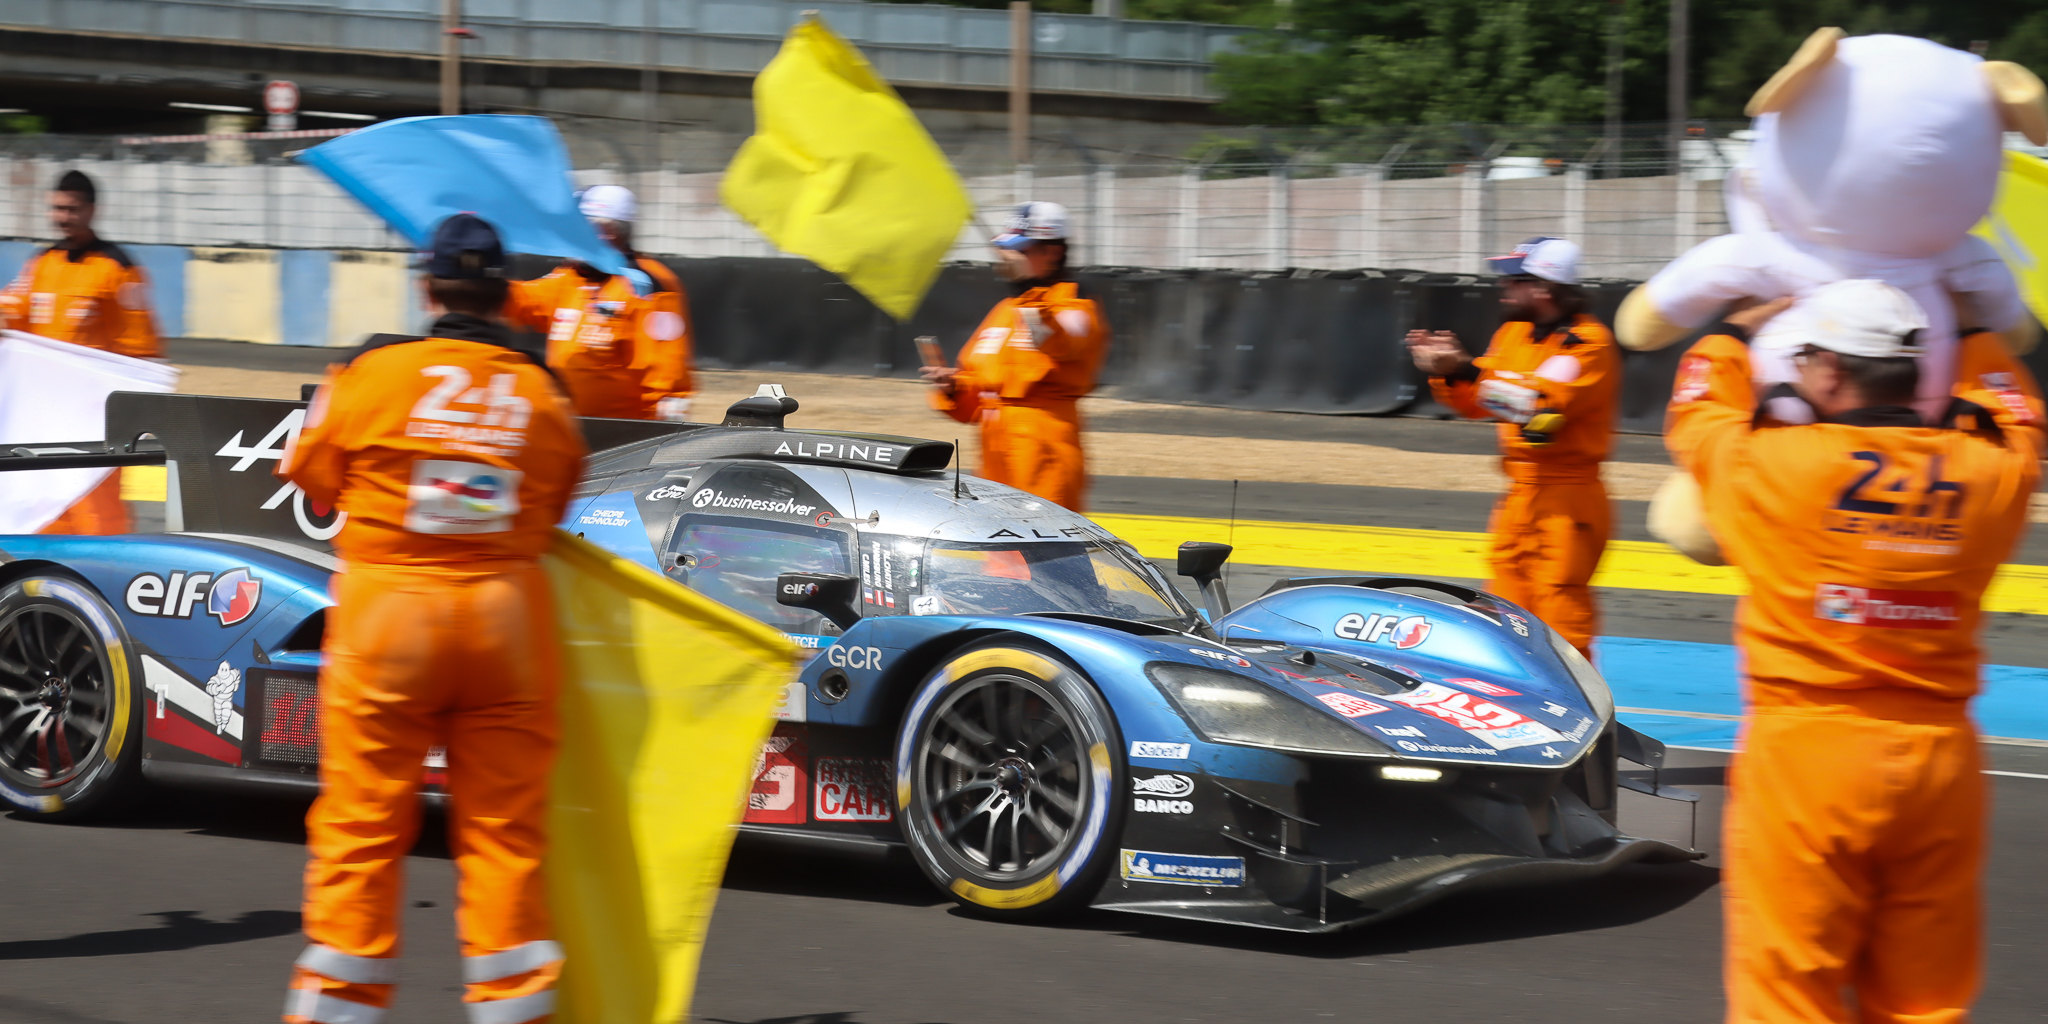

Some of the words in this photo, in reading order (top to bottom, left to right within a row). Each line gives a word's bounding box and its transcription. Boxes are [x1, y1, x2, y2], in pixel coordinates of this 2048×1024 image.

[775, 441, 893, 462] ALPINE
[592, 509, 625, 518] CHEOPS
[713, 491, 816, 517] businessolver
[580, 516, 631, 527] TECHNOLOGY
[127, 572, 210, 617] elf
[783, 583, 805, 594] elf
[1335, 613, 1400, 643] elf
[827, 644, 882, 671] GCR
[820, 783, 888, 816] CAR
[1134, 798, 1194, 815] BAHCO
[1153, 863, 1241, 879] MICHELIN
